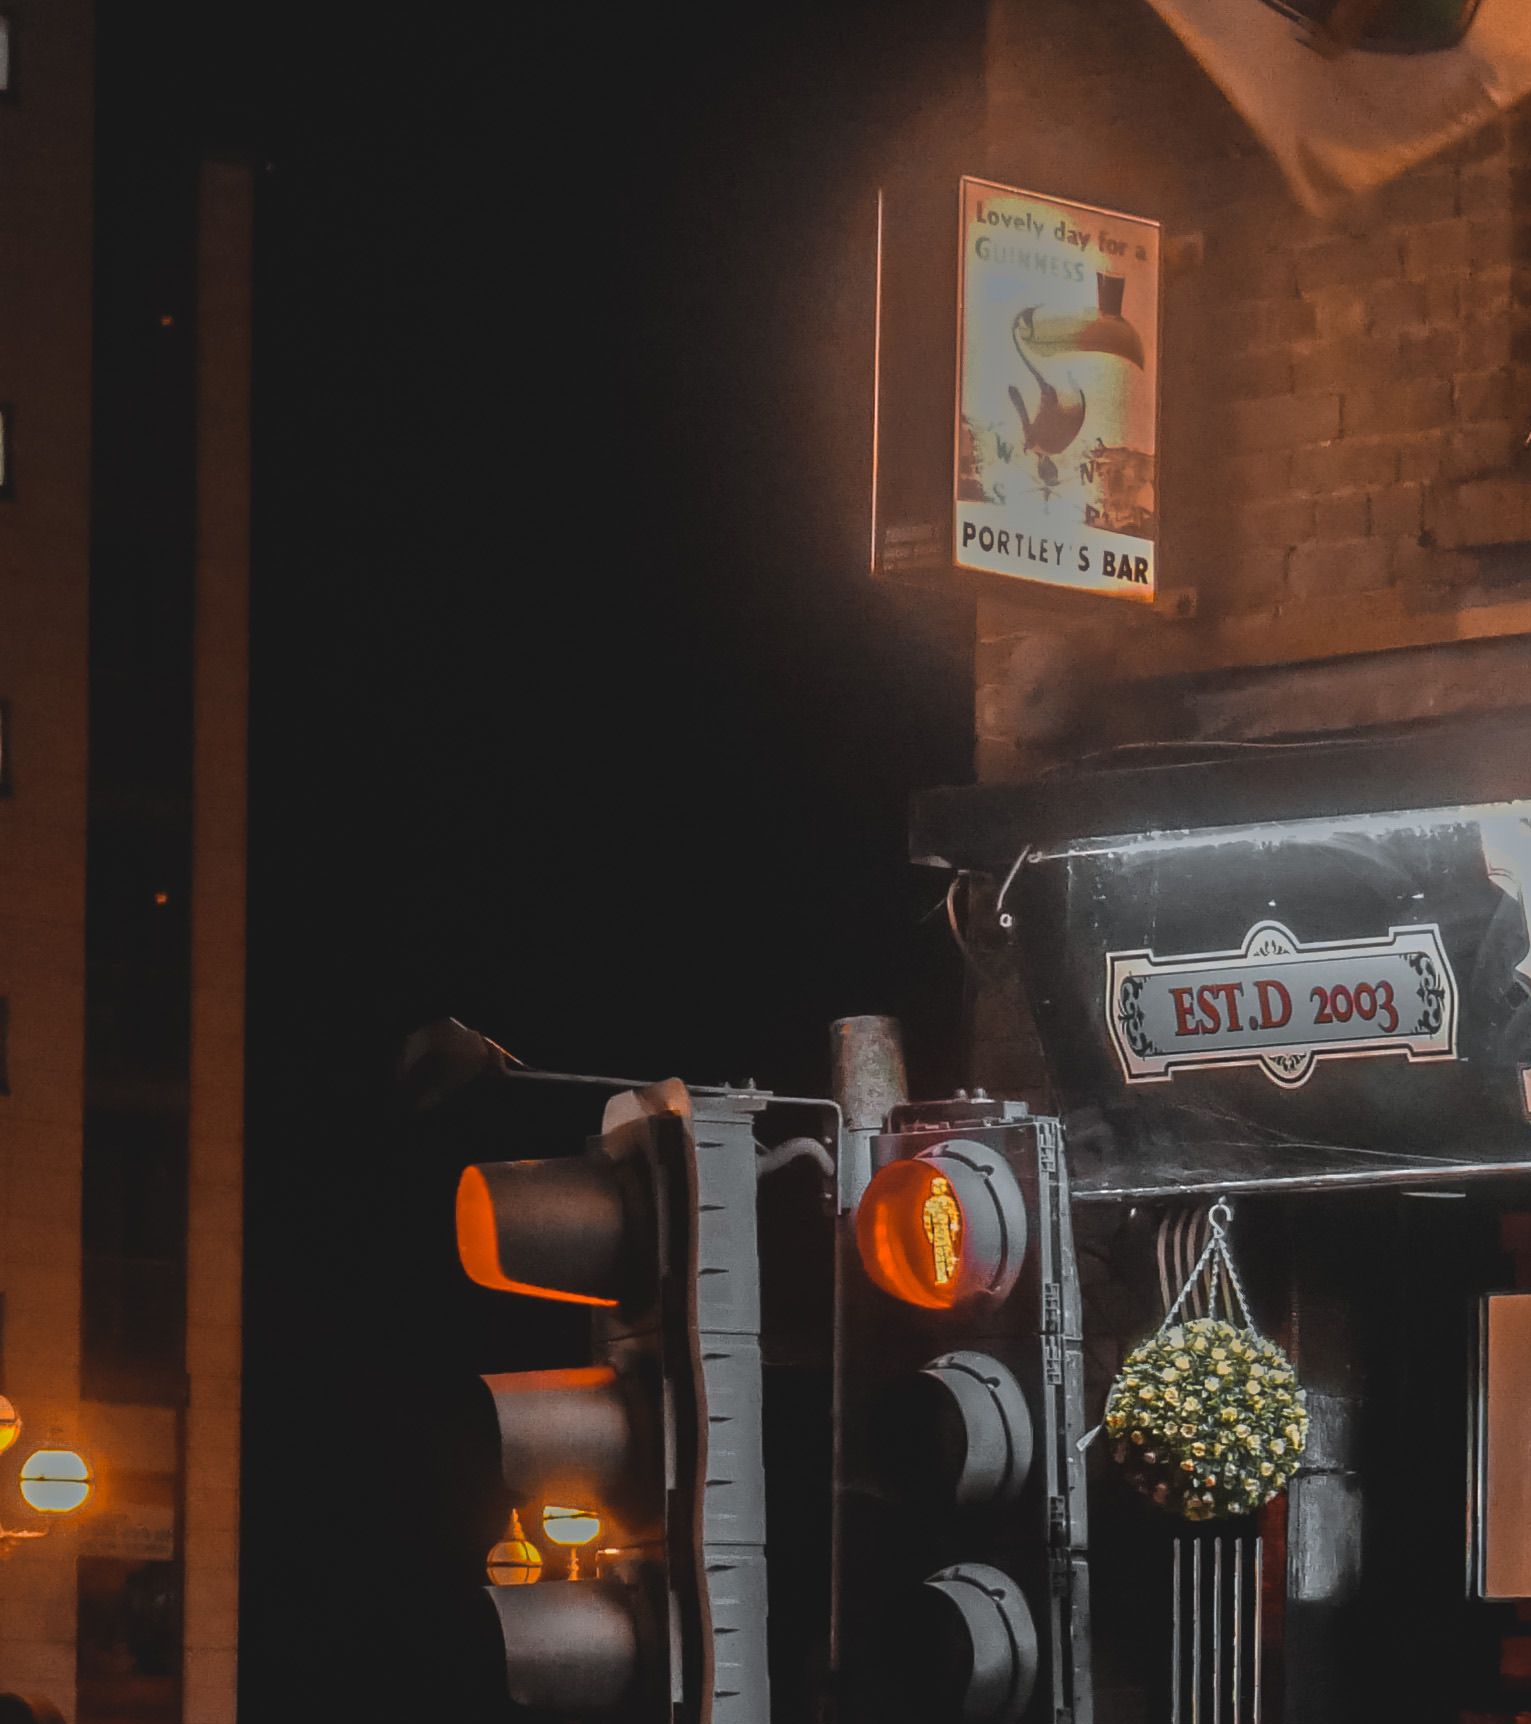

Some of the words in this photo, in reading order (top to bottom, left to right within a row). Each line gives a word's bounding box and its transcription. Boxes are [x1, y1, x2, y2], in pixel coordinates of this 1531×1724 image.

[976, 201, 1044, 240] Lovely
[1054, 221, 1091, 252] day
[1098, 231, 1128, 256] for
[1135, 245, 1147, 261] a
[1102, 550, 1149, 584] BAR
[1169, 978, 1292, 1036] EST.D
[1310, 980, 1399, 1034] 2003
